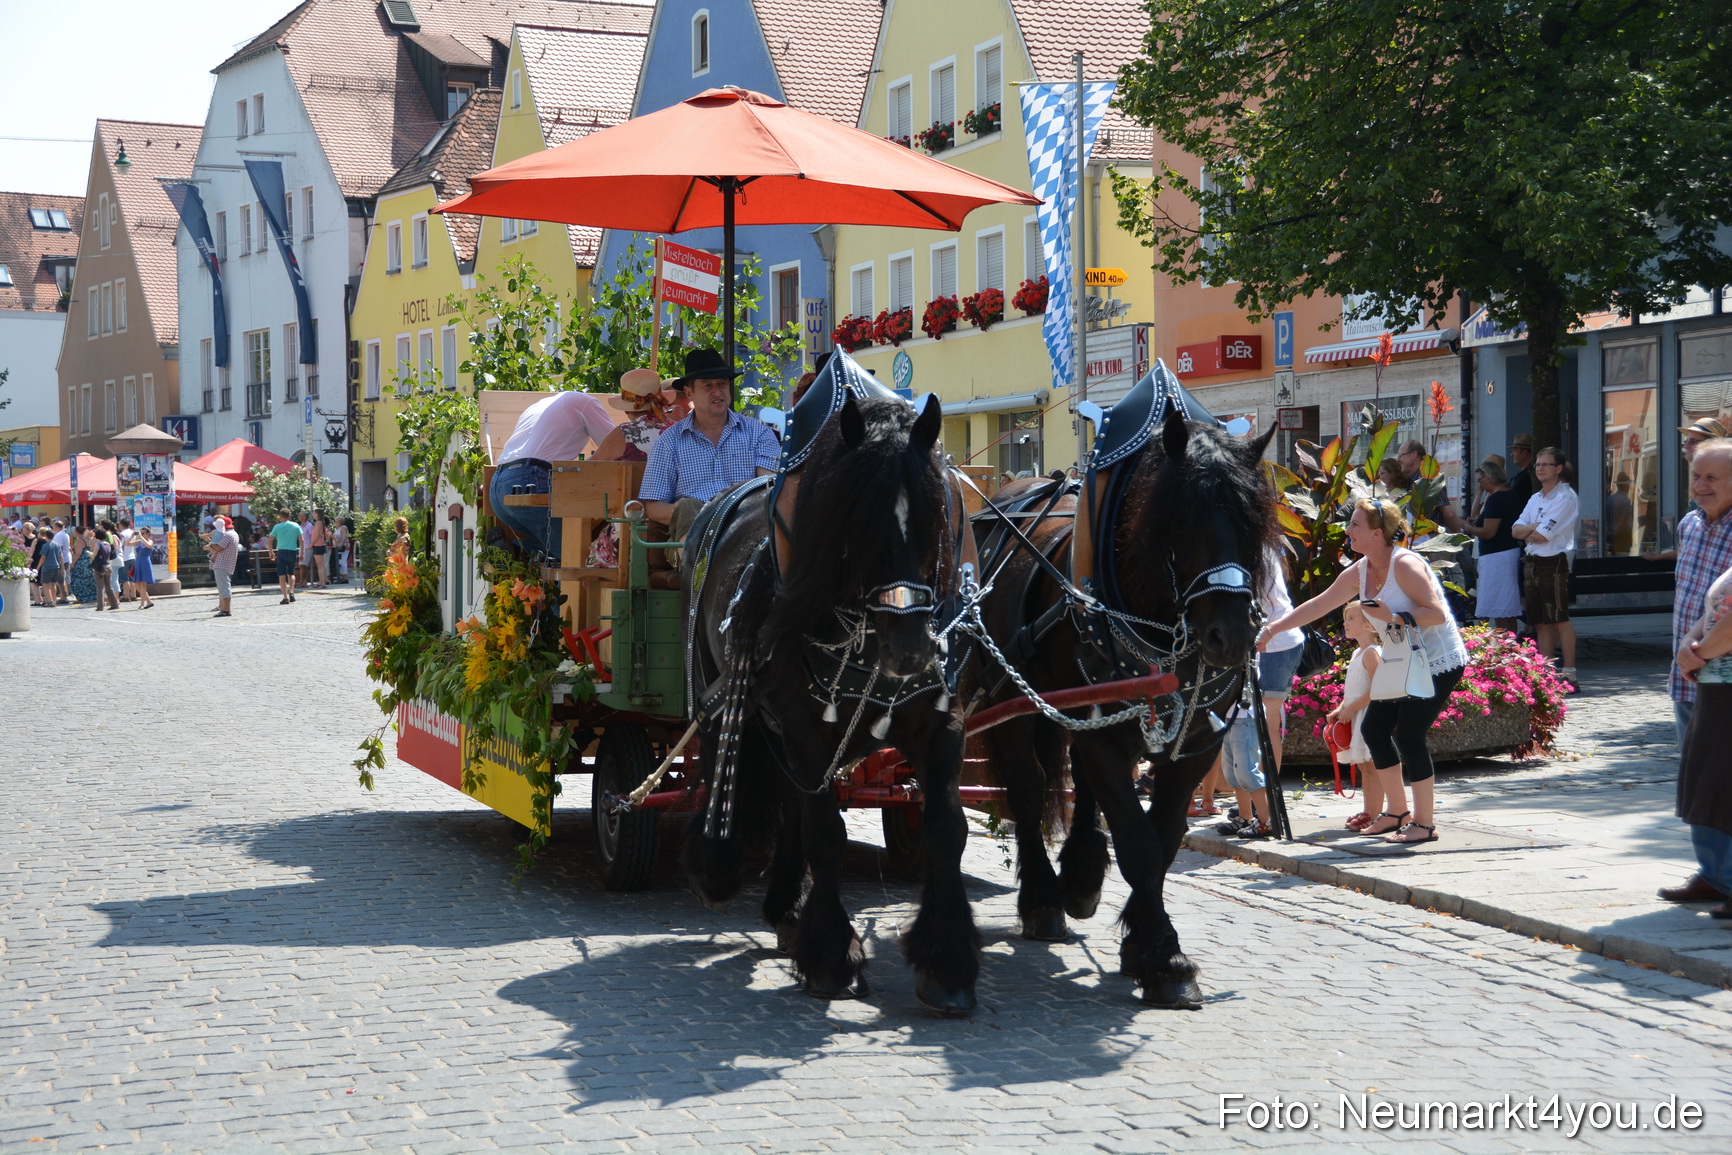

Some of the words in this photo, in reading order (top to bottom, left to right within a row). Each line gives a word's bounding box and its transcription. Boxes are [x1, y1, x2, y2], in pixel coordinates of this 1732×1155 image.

[663, 244, 713, 271] Mistelbach
[670, 267, 700, 285] grüßt
[1085, 271, 1106, 283] KINO
[402, 298, 430, 325] HOTEL
[806, 300, 824, 316] CAFÉ
[1278, 319, 1290, 360] P
[1226, 345, 1253, 358] DER
[1105, 359, 1122, 375] KINO
[1178, 356, 1194, 373] DER
[1484, 380, 1494, 395] 16
